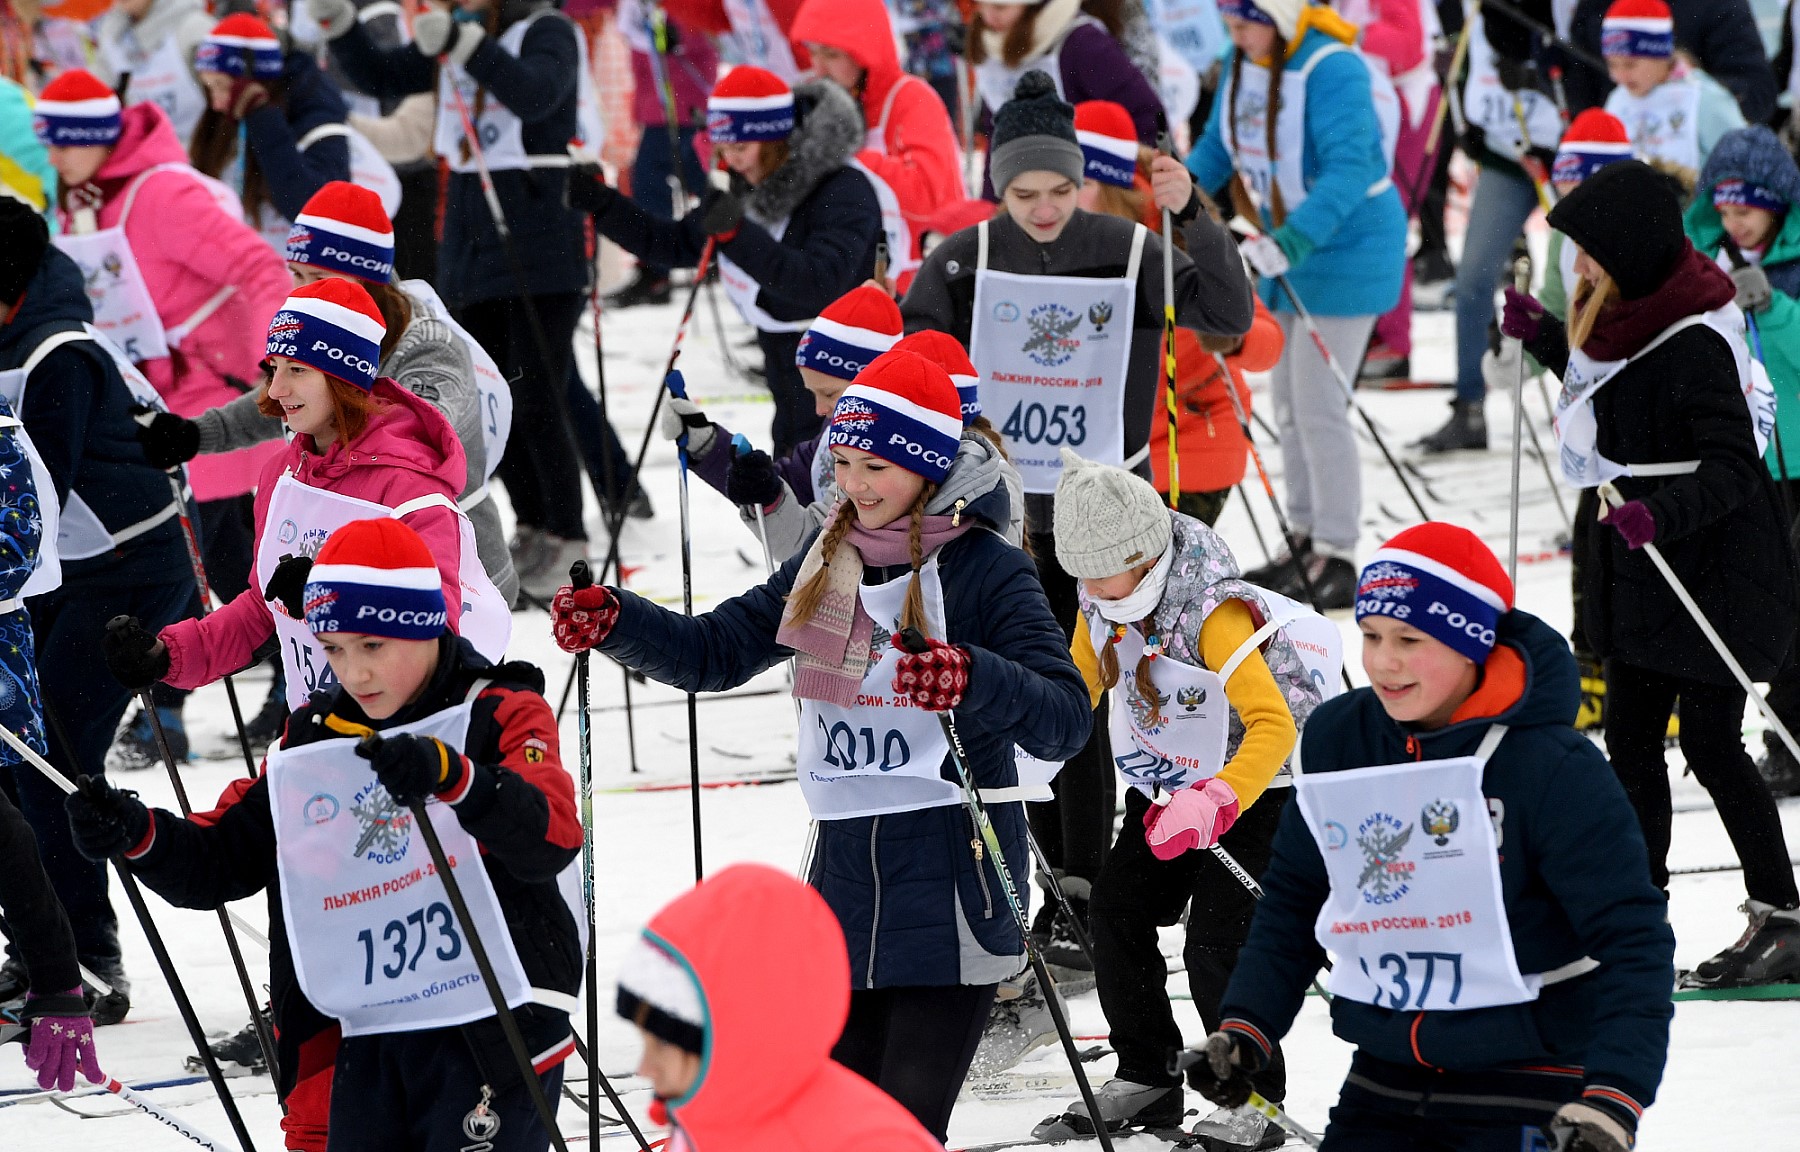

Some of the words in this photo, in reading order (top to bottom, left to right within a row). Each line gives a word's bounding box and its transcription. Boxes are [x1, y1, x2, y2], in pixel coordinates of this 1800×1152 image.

[266, 342, 298, 357] 2018
[1033, 376, 1079, 388] РОССИИ
[1001, 399, 1087, 446] 4053
[830, 432, 874, 451] 2018
[1357, 599, 1412, 619] 2018
[1174, 755, 1200, 770] 2018
[323, 886, 382, 911] ЛЫЖНЯ
[383, 868, 422, 895] РОССИИ
[1371, 916, 1429, 933] РОССИИ
[1437, 910, 1473, 929] 2018
[357, 901, 462, 985] 1373
[422, 971, 480, 998] область
